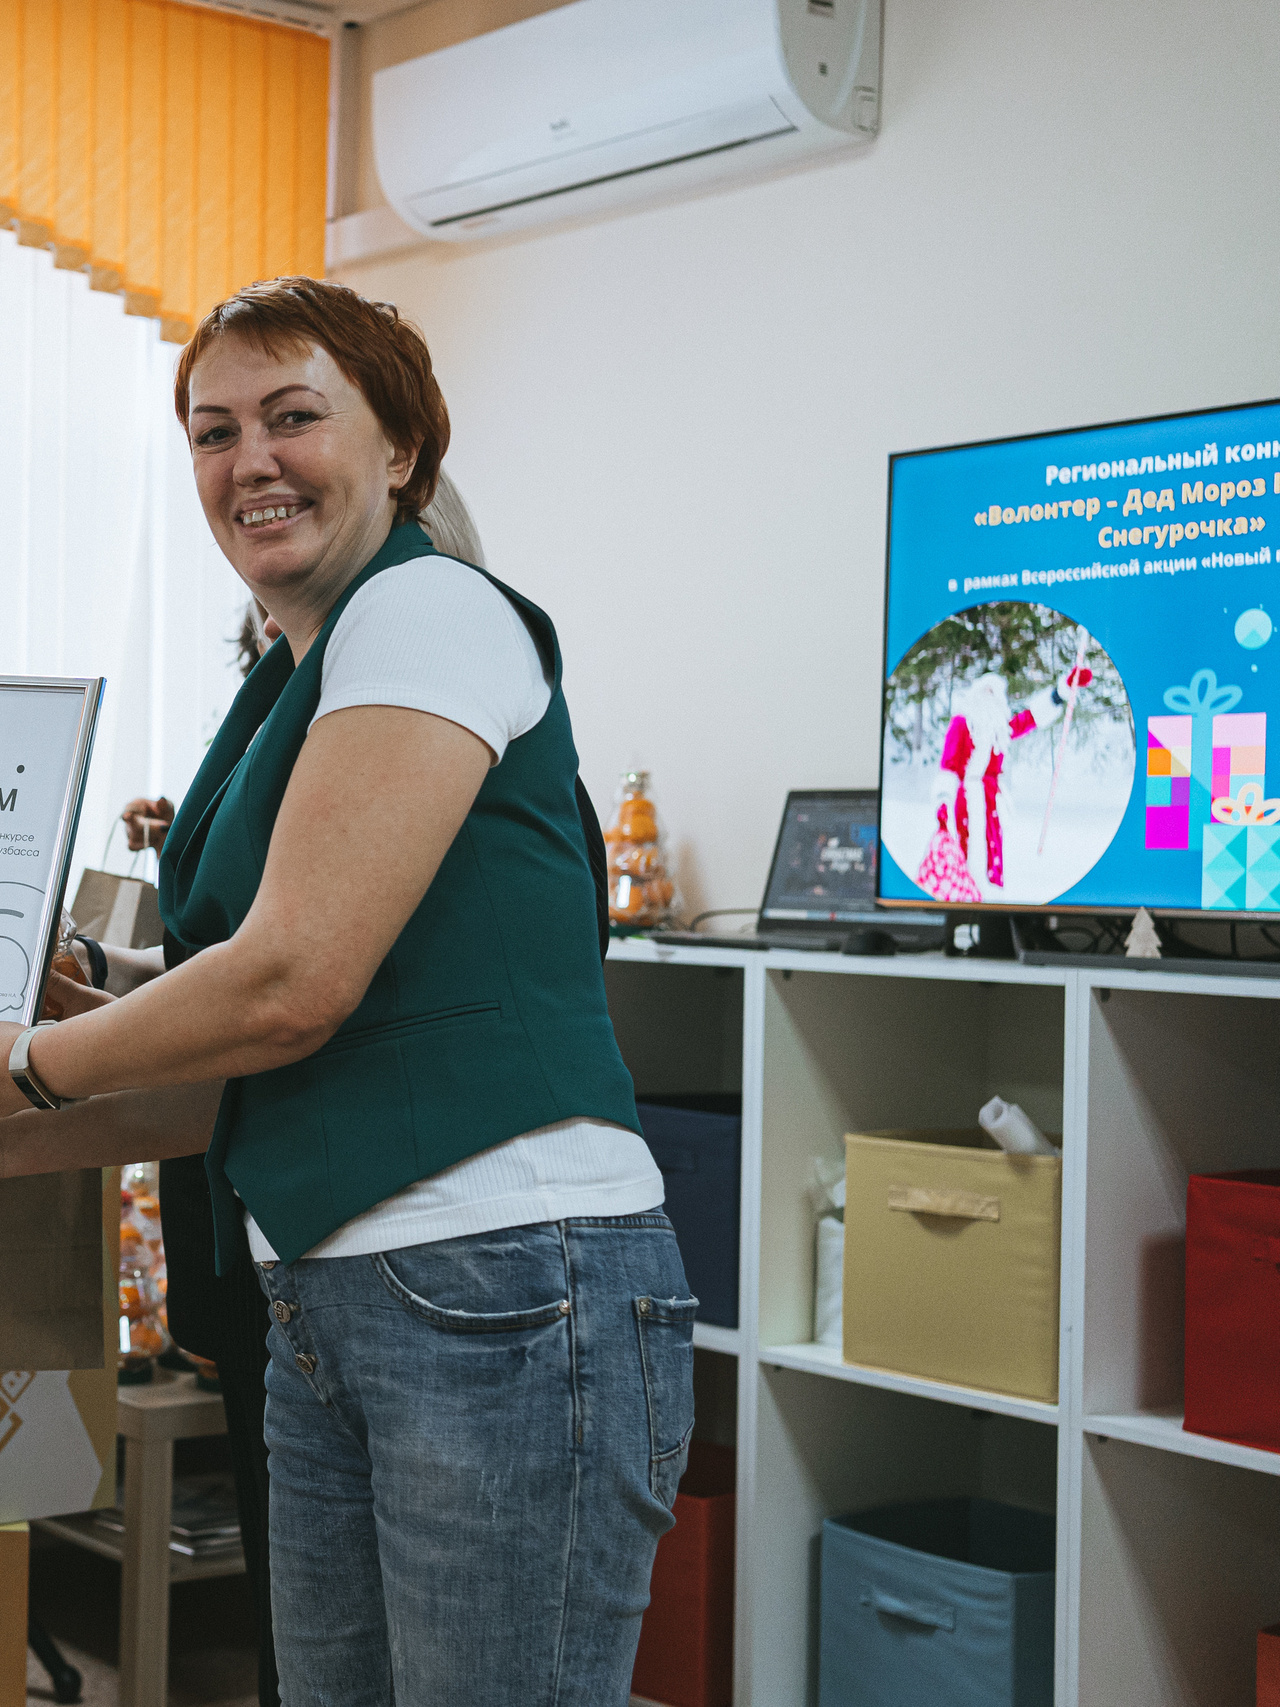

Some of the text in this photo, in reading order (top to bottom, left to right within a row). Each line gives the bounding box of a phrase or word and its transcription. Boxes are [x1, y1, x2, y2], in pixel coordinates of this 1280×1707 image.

[1045, 442, 1219, 486] Региональный
[974, 496, 1101, 527] «Волонтер
[1122, 488, 1176, 517] Дед
[1181, 478, 1267, 507] Мороз
[1098, 516, 1266, 549] Снегурочка»
[964, 569, 1019, 594] рамках
[1021, 558, 1140, 587] Всероссийской
[1143, 556, 1197, 577] акции
[1201, 546, 1271, 570] «Новый
